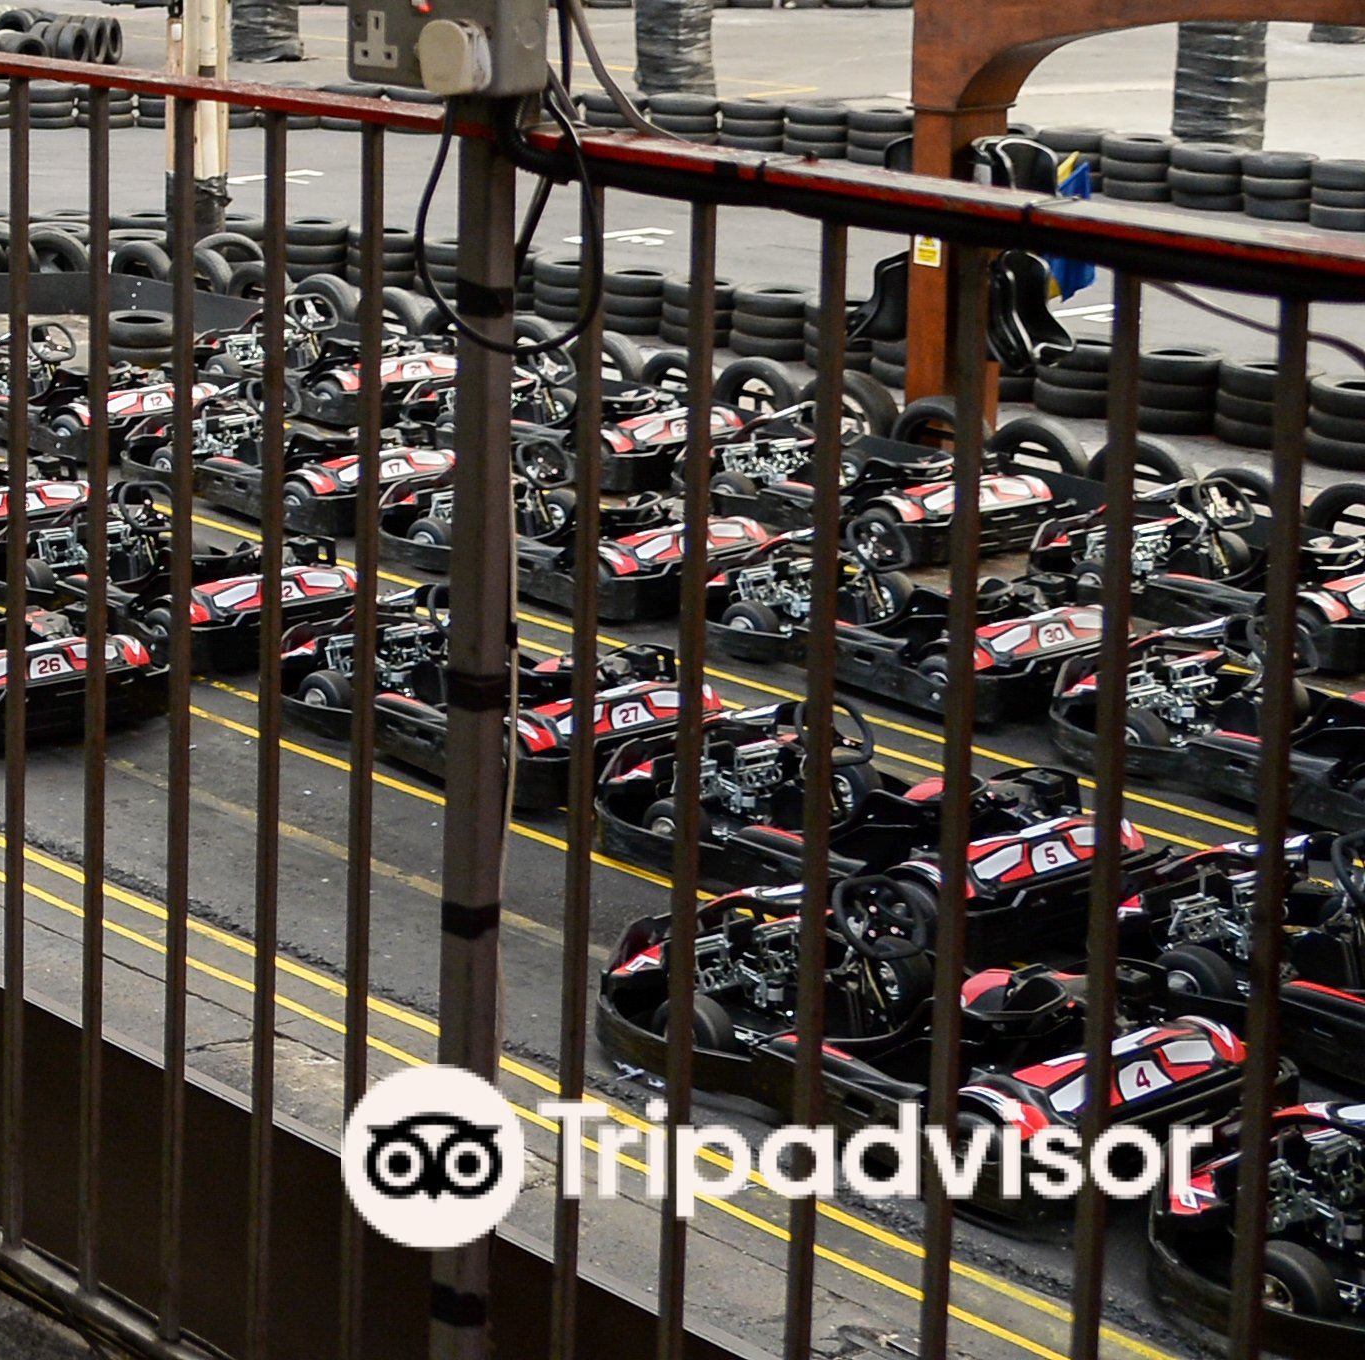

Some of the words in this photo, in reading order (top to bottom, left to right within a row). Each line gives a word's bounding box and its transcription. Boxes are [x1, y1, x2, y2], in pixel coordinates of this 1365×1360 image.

[1044, 626, 1065, 643] 30
[37, 657, 61, 675] 26
[618, 706, 639, 724] 27
[1044, 846, 1058, 865] 5
[1136, 1066, 1151, 1088] 4
